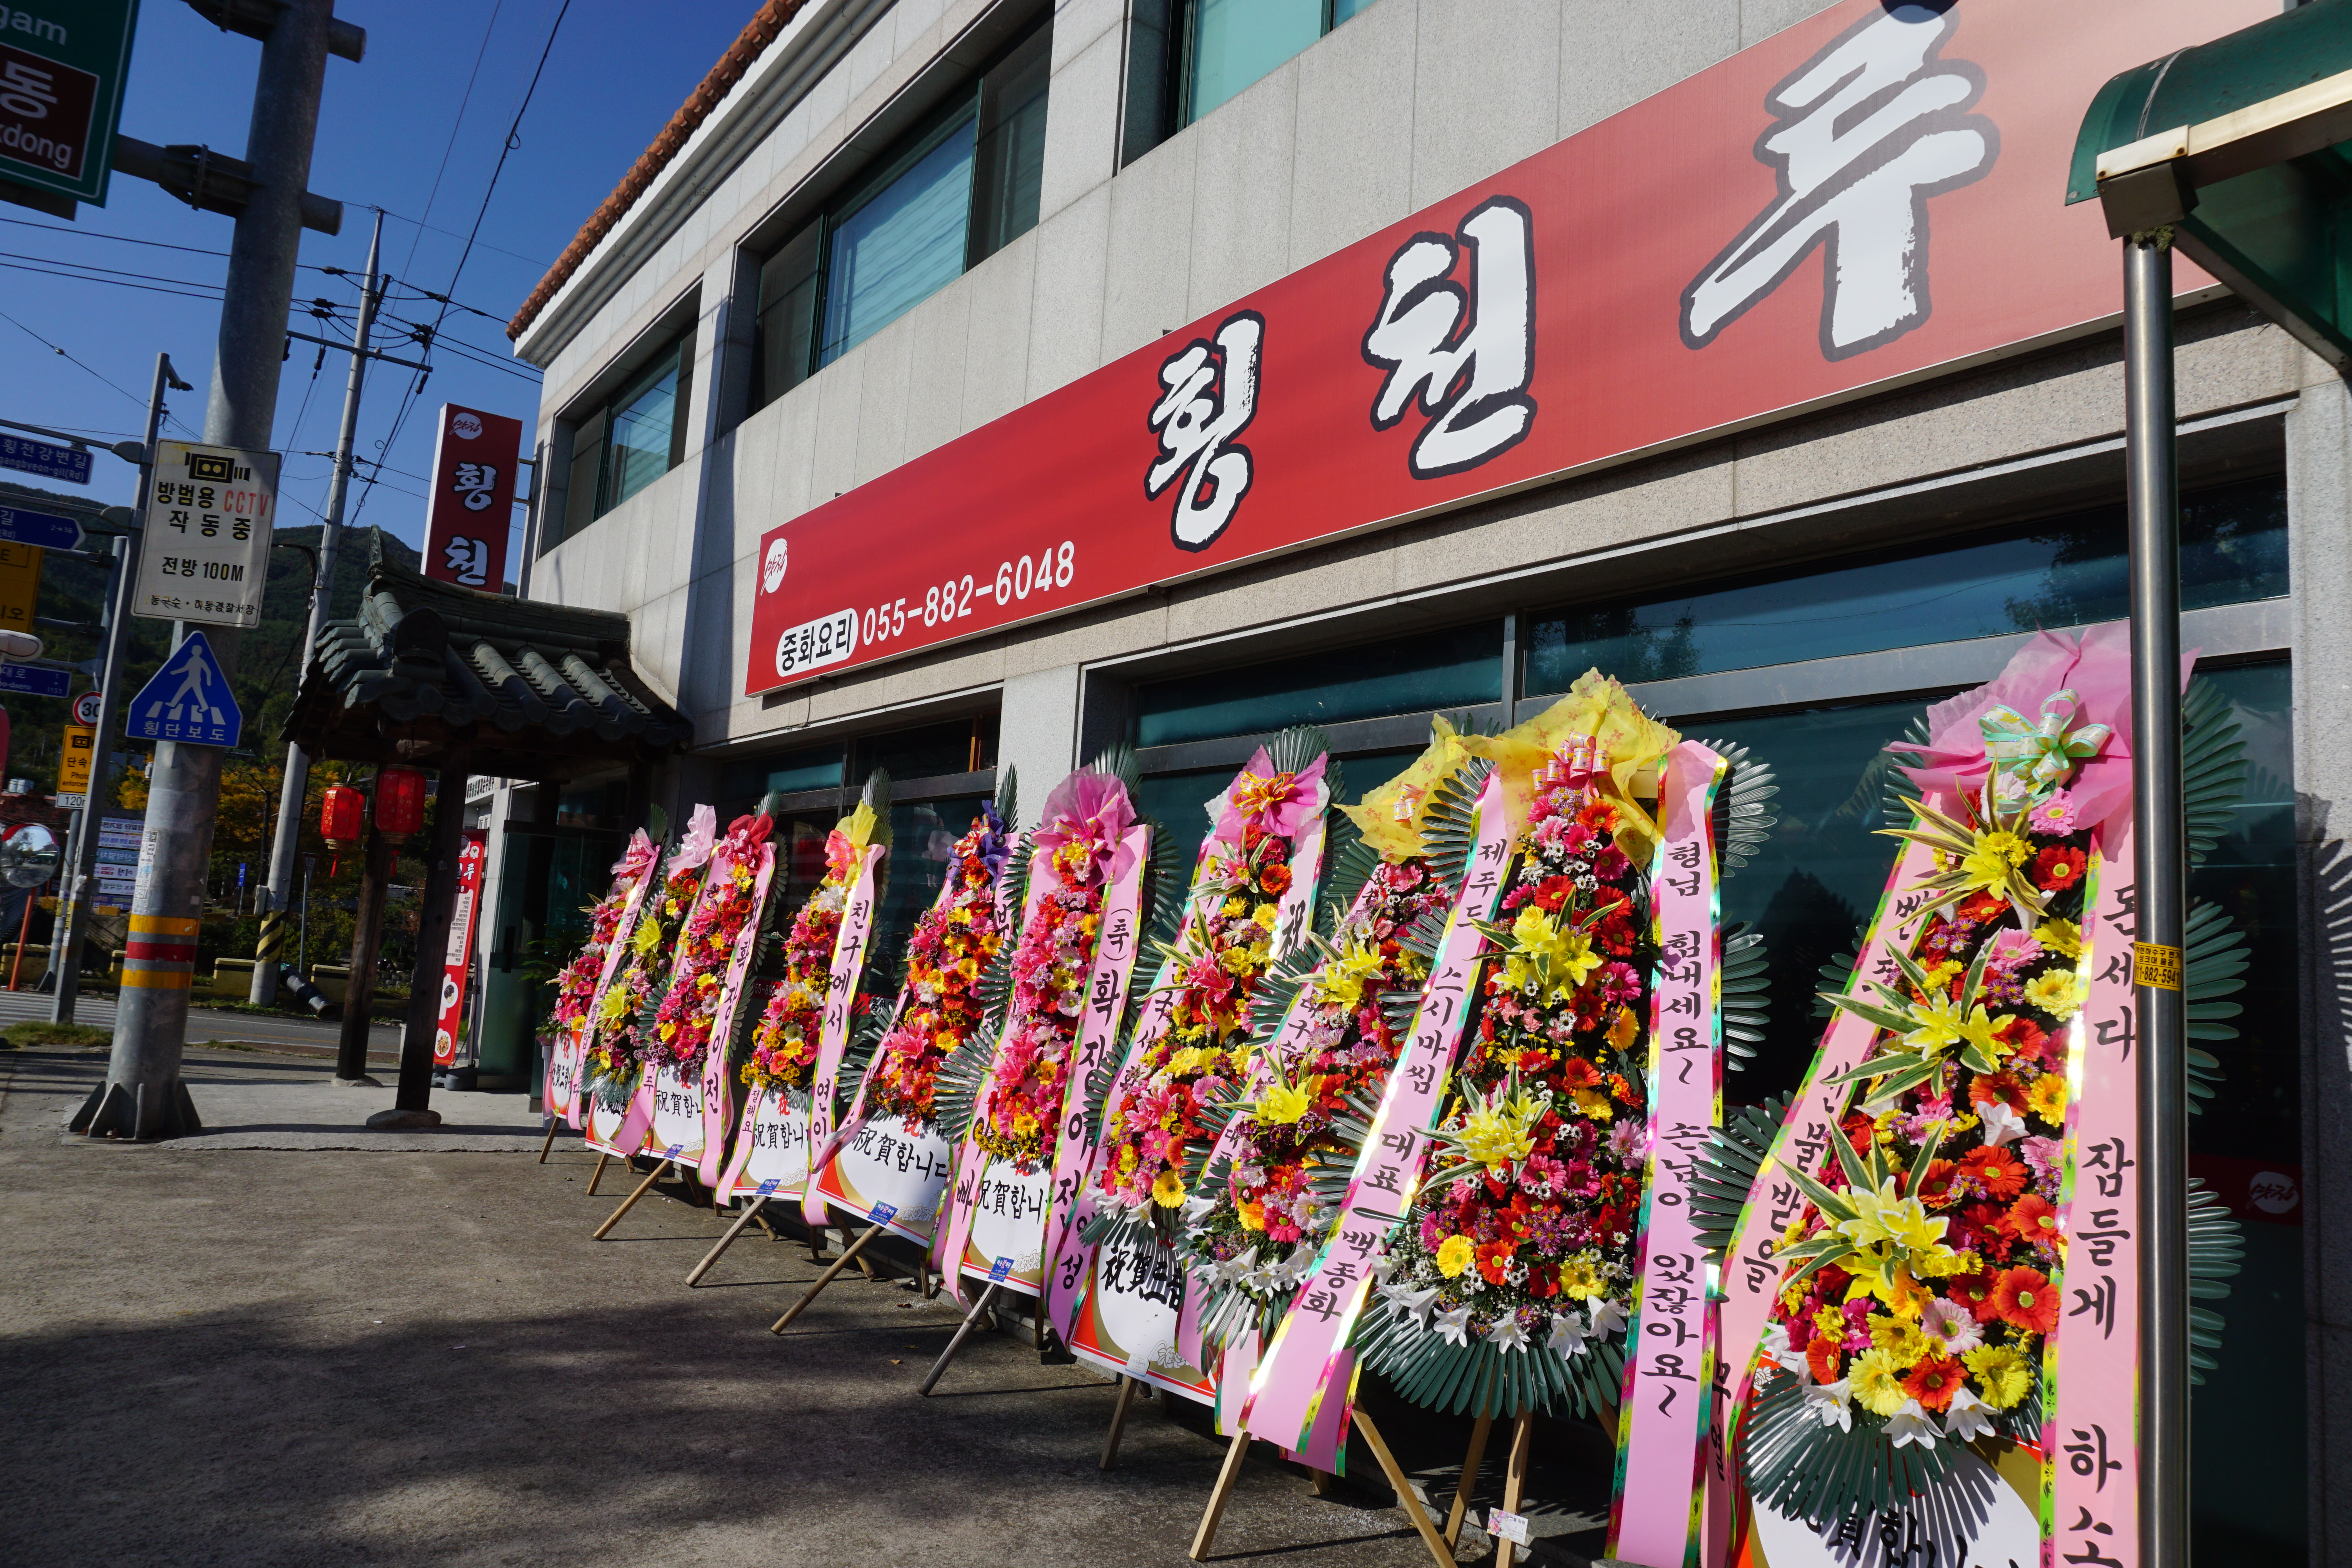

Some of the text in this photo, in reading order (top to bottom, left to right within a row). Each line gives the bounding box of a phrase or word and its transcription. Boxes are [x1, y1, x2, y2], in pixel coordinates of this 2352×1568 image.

[0, 123, 72, 169] dong
[3, 438, 86, 469] 횡천강변길
[158, 481, 269, 516] 방범용 CCTV
[162, 557, 244, 582] 전방 100M
[863, 541, 1074, 646] 055-882-6048
[782, 613, 853, 671] 중화요리
[143, 721, 225, 741] 횡단보도
[1456, 838, 1508, 928] 제주도
[1665, 841, 1701, 897] 형님
[826, 900, 869, 1037] 친구에서
[755, 1122, 810, 1150] 祝賀합니
[1363, 1131, 1416, 1196] 대표
[2068, 1137, 2135, 1340] 잠들게
[1301, 1229, 1377, 1323] 백종화
